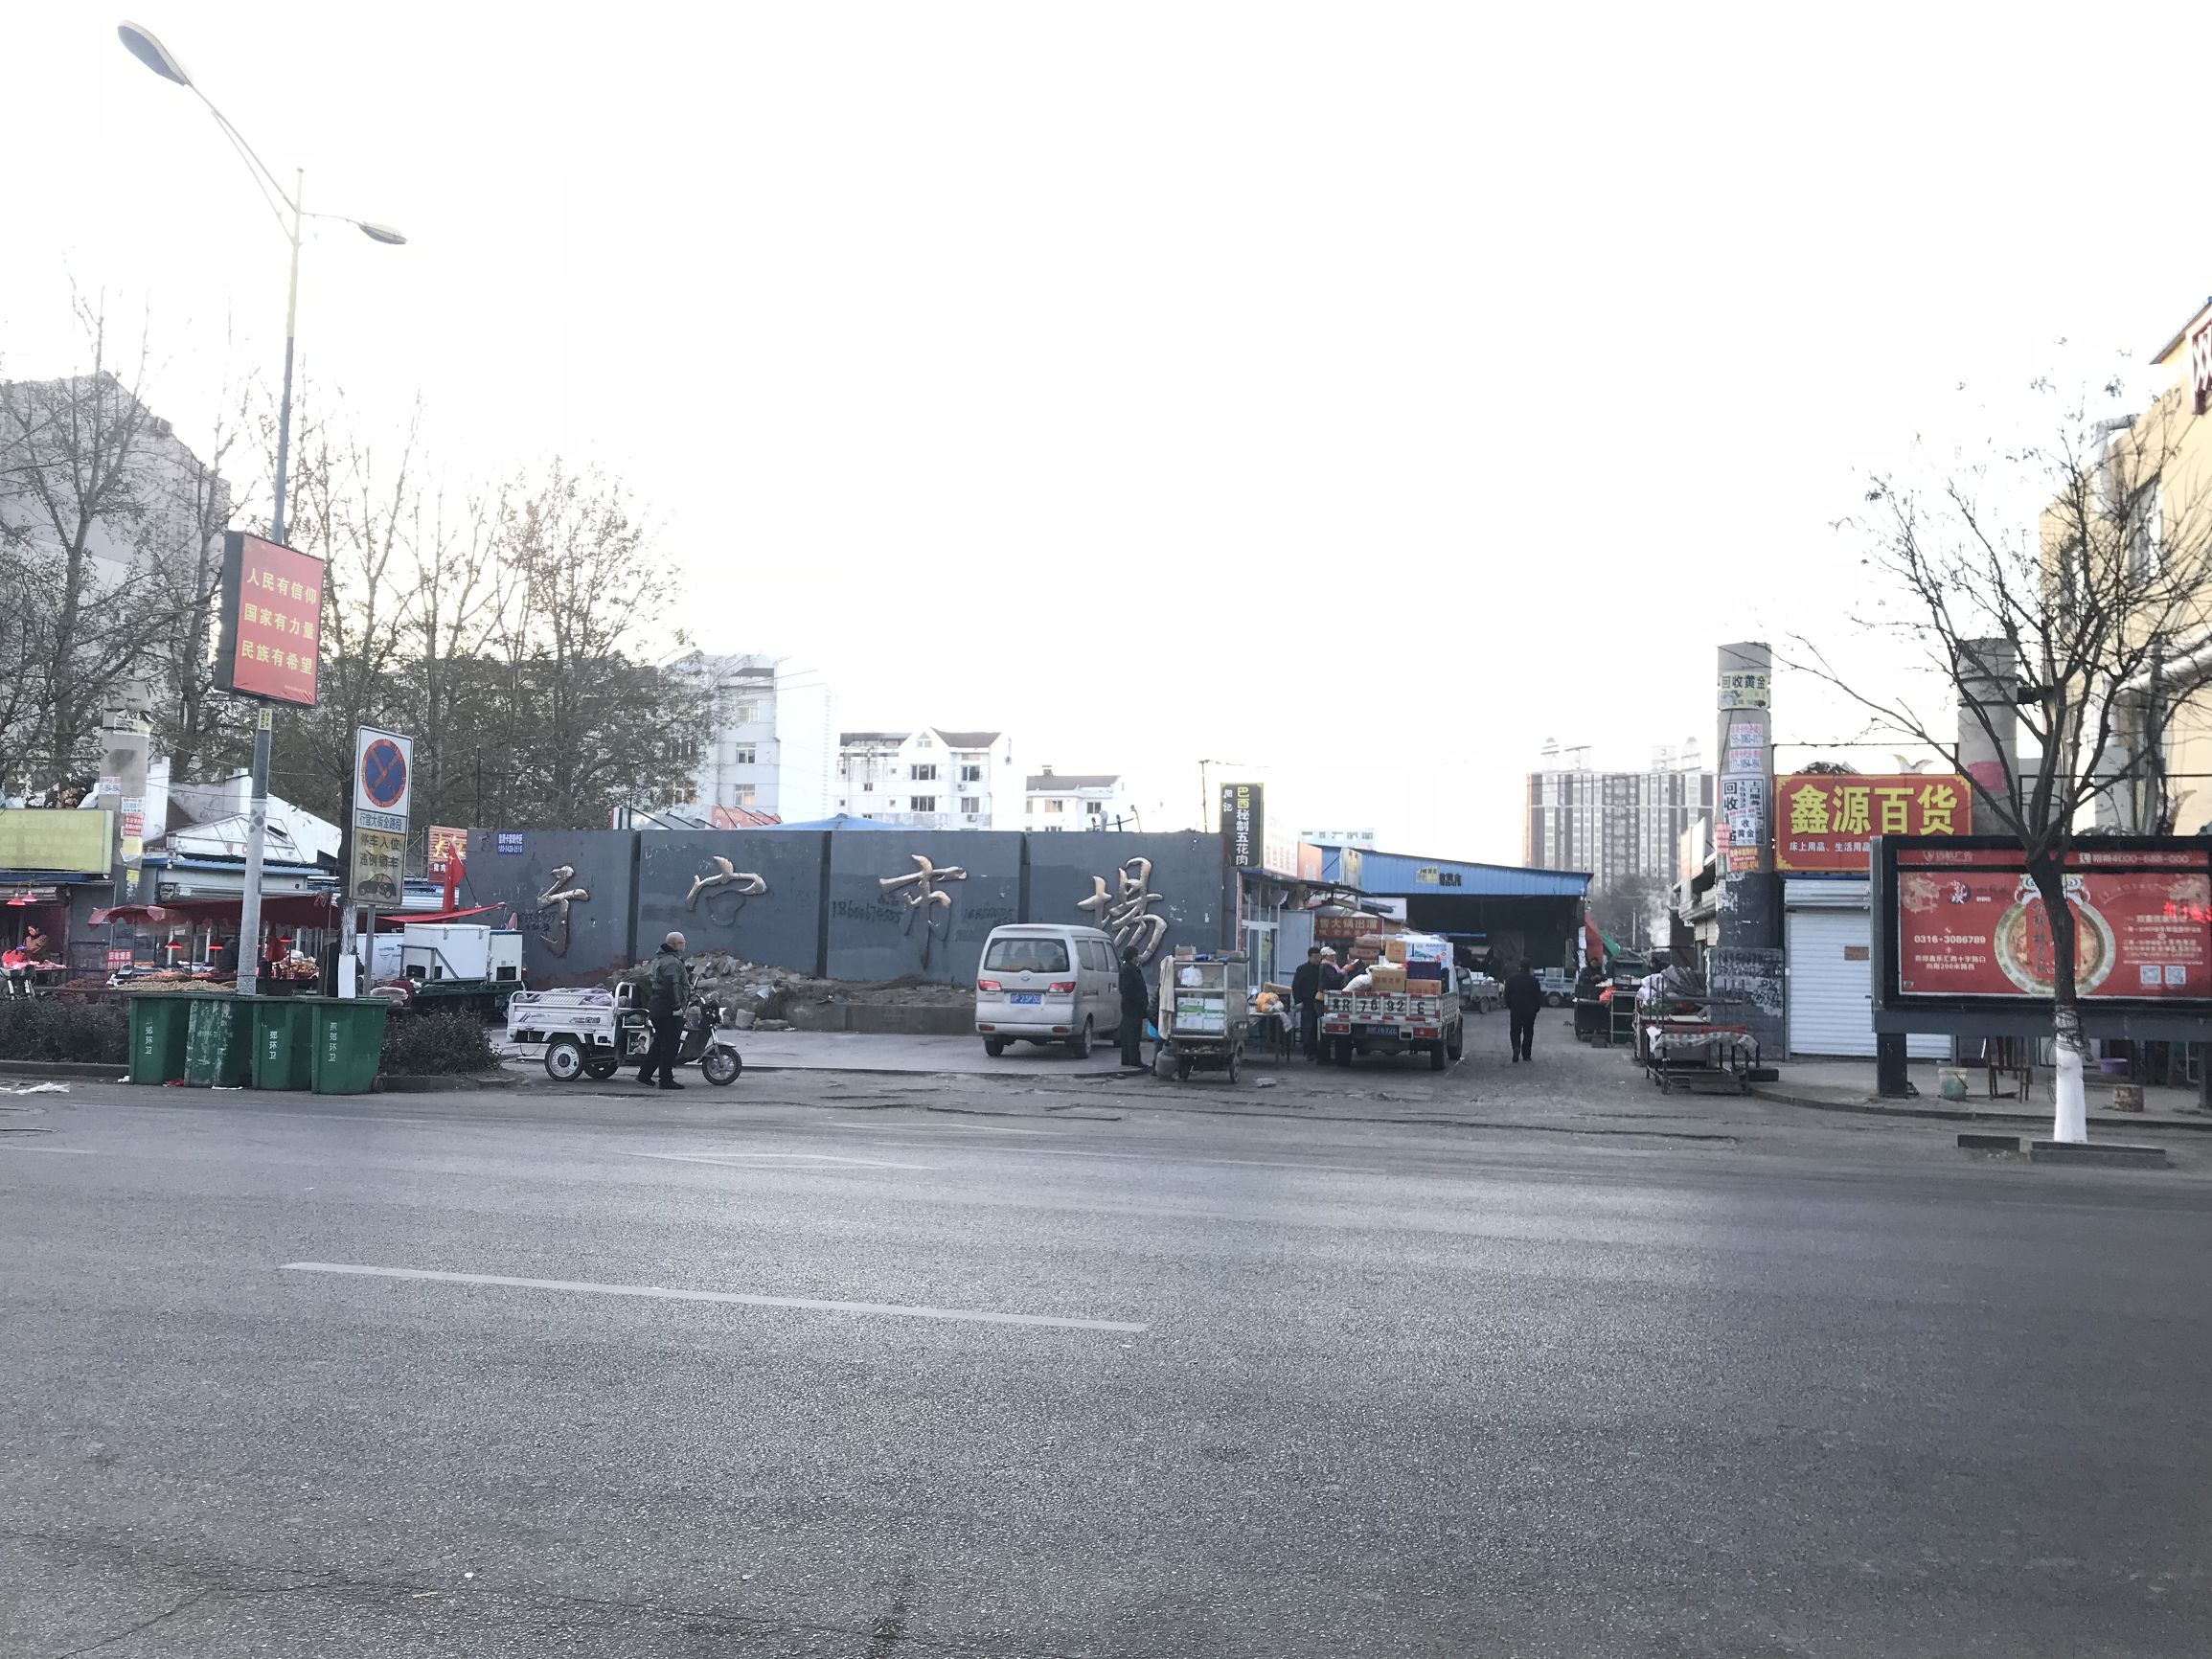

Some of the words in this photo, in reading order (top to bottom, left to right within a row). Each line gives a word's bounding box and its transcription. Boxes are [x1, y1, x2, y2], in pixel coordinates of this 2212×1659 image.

[246, 567, 316, 606] 人民有信仰
[243, 602, 314, 641] 国家有力量
[241, 639, 312, 675] 民族有希望
[1722, 674, 1766, 689] 回收黄金
[359, 812, 402, 831] 行宫大街全路段
[1236, 785, 1250, 866] 巴西秘制五花肉
[1790, 784, 1958, 835] 鑫源百货
[359, 832, 400, 851] 停车入位
